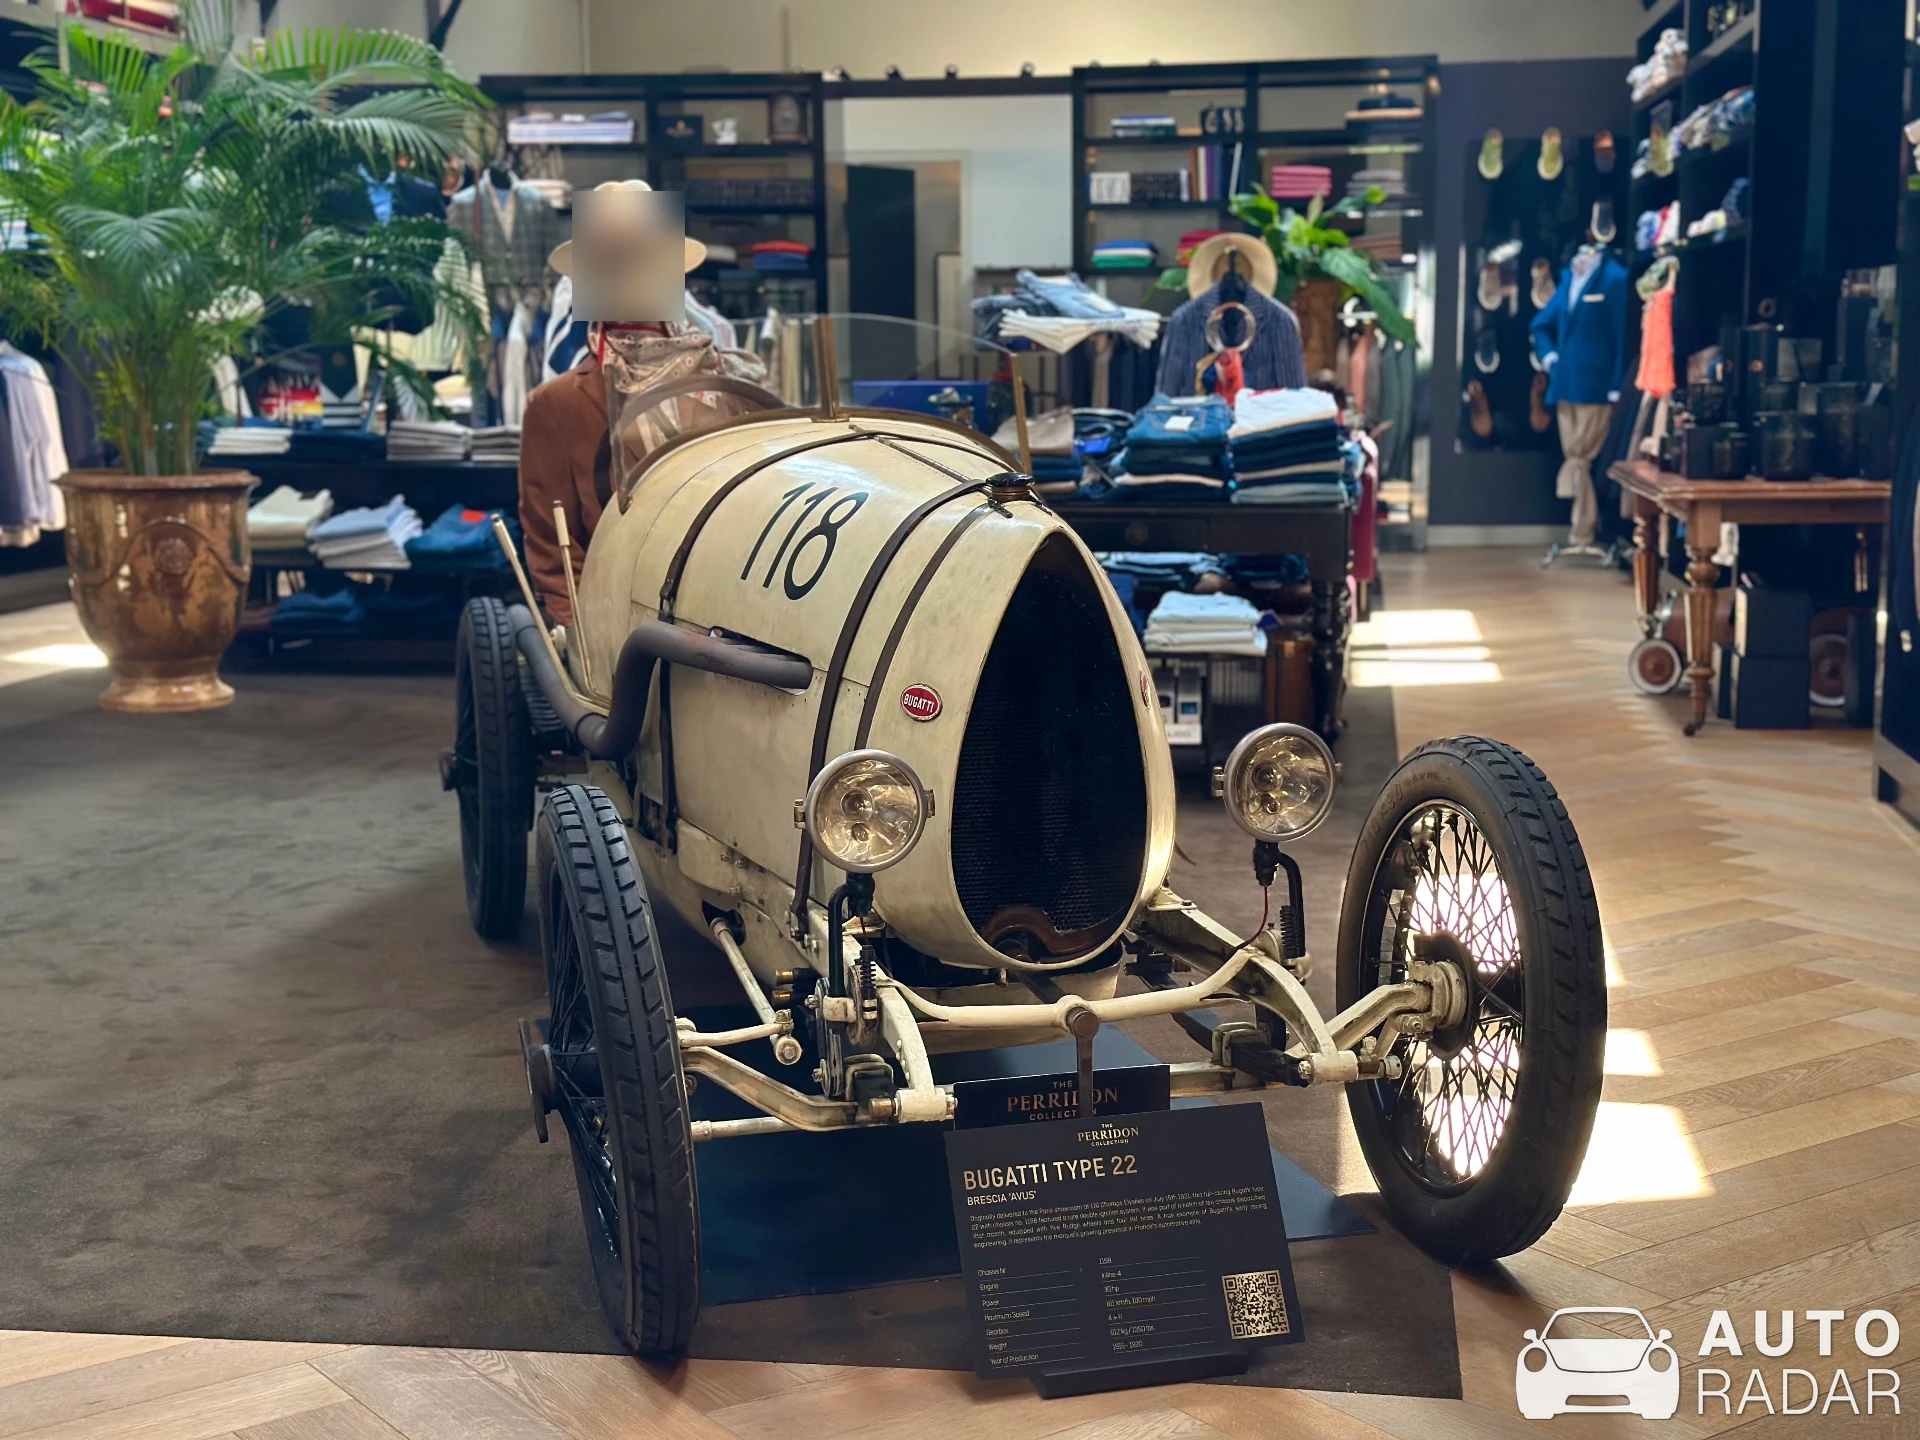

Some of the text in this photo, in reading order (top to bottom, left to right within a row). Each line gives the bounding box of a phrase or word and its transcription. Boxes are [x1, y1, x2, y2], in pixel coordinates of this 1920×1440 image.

[740, 481, 869, 601] 118
[903, 693, 935, 713] BUGATTI
[1052, 1080, 1073, 1089] THE
[1029, 1107, 1097, 1120] COLLECTN
[1077, 1127, 1139, 1141] PERRIDON
[1091, 1139, 1129, 1147] COLLECTION
[963, 1154, 1138, 1190] BUGATTI TYPE 22
[967, 1190, 1036, 1206] BRESCIA 'AVUS'
[979, 1283, 999, 1291] Engine
[1012, 1310, 1030, 1319] Speed
[988, 1342, 1007, 1351] Weight
